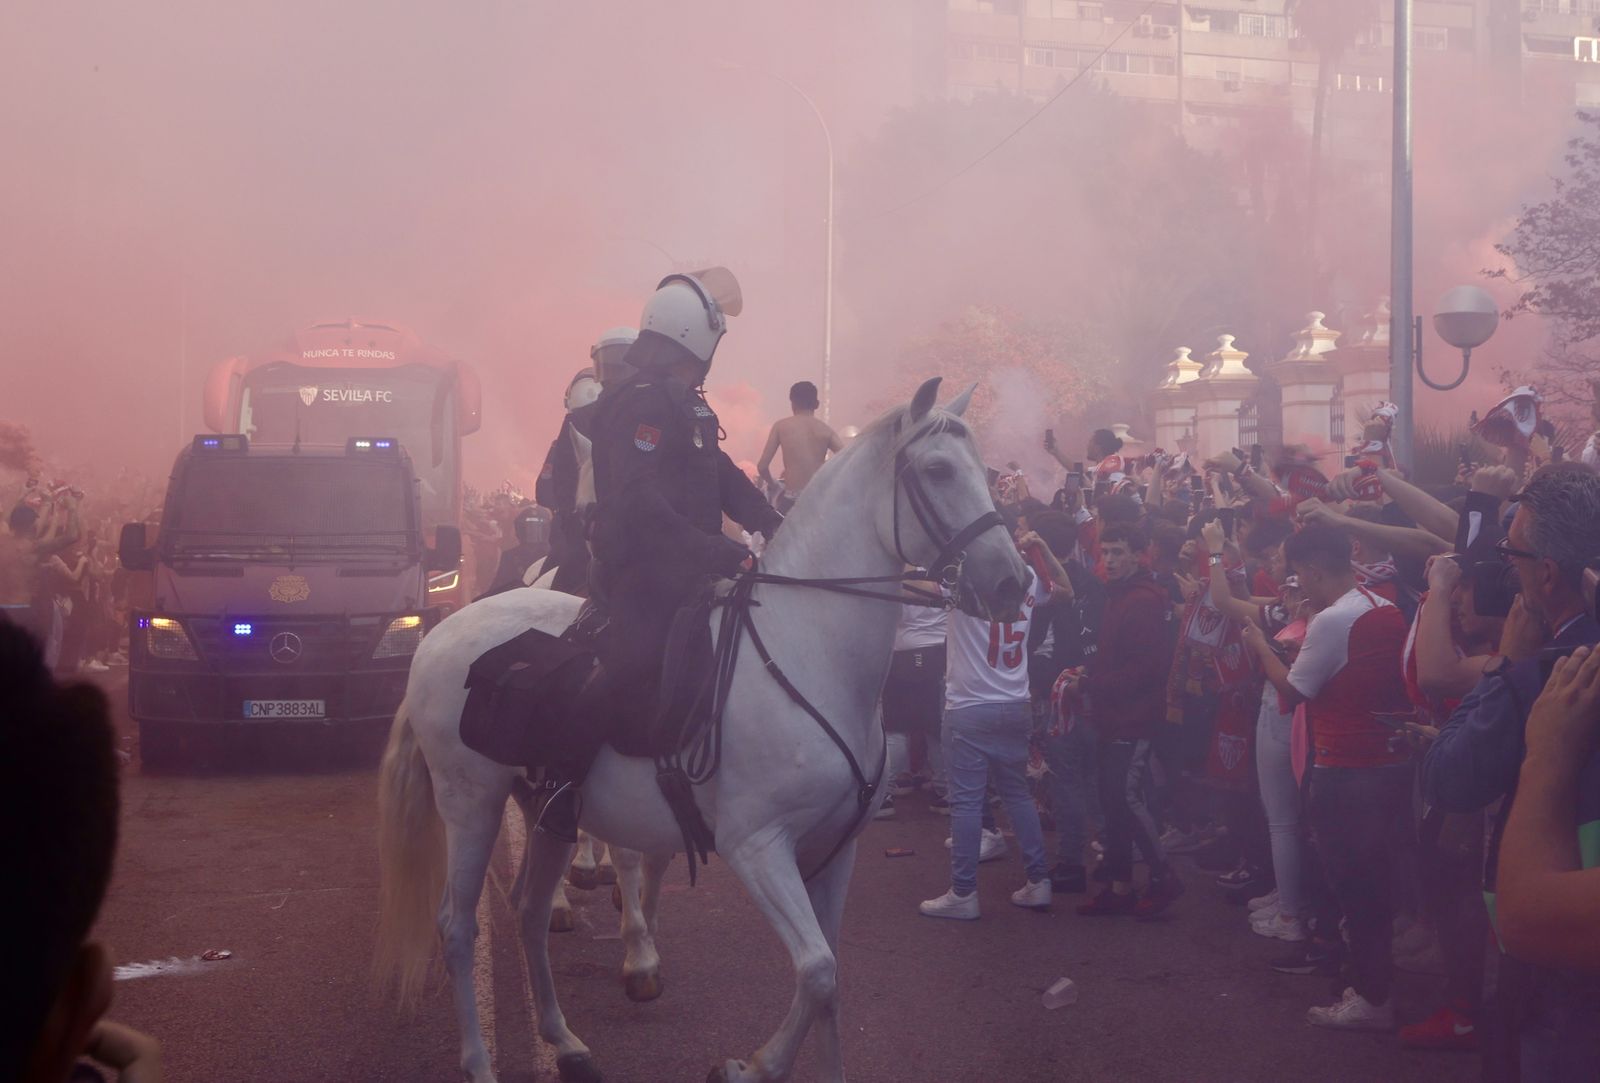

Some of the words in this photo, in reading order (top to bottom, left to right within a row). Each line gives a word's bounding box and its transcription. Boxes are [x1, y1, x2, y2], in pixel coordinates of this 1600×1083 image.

[303, 348, 340, 359] NUNCA
[341, 348, 354, 358] TE
[357, 349, 396, 360] RINDAS
[322, 389, 373, 402] SEVILLA
[375, 390, 393, 403] FC
[987, 612, 1028, 669] 15
